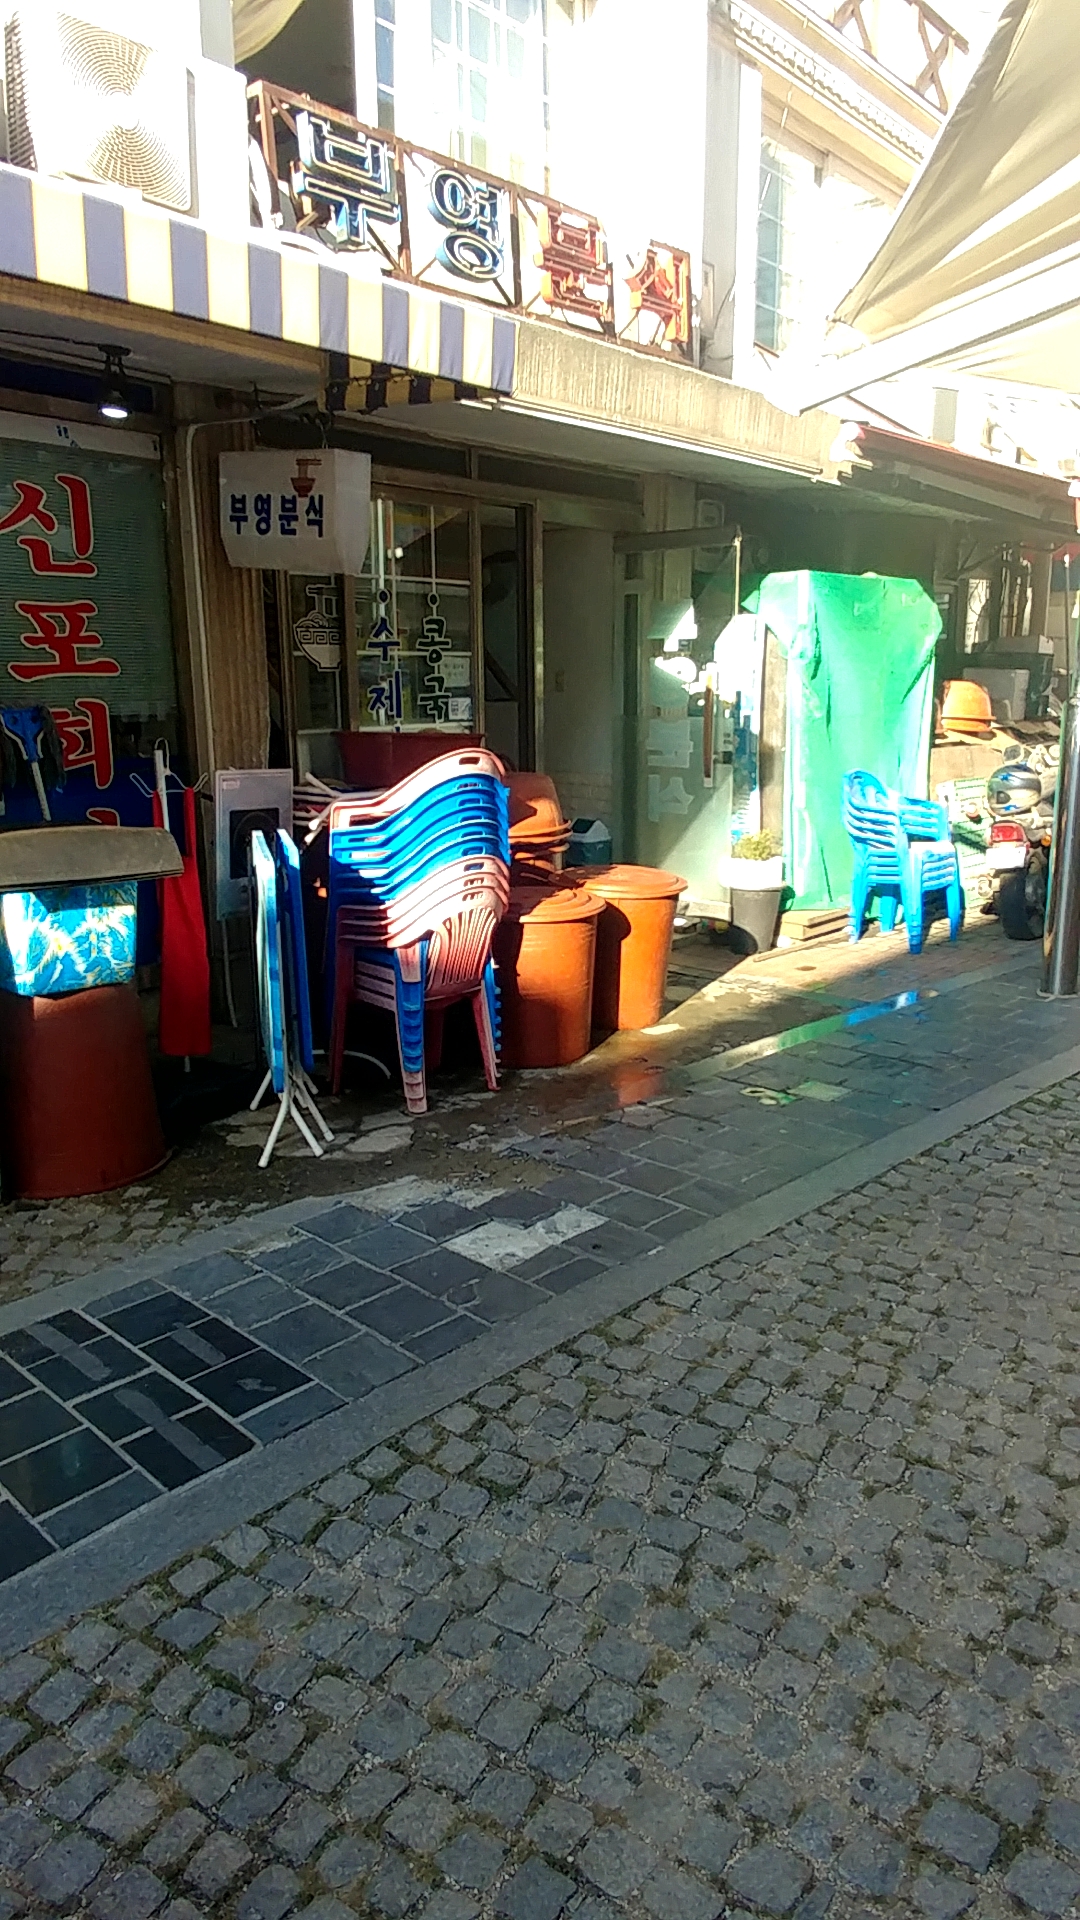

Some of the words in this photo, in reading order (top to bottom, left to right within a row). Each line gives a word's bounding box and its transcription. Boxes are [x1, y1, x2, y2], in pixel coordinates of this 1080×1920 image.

[291, 112, 690, 344] 부영분식
[229, 493, 324, 538] 부영분식
[0, 473, 121, 826] 신포회
[367, 616, 402, 732] 수제
[416, 616, 452, 722] 콩국
